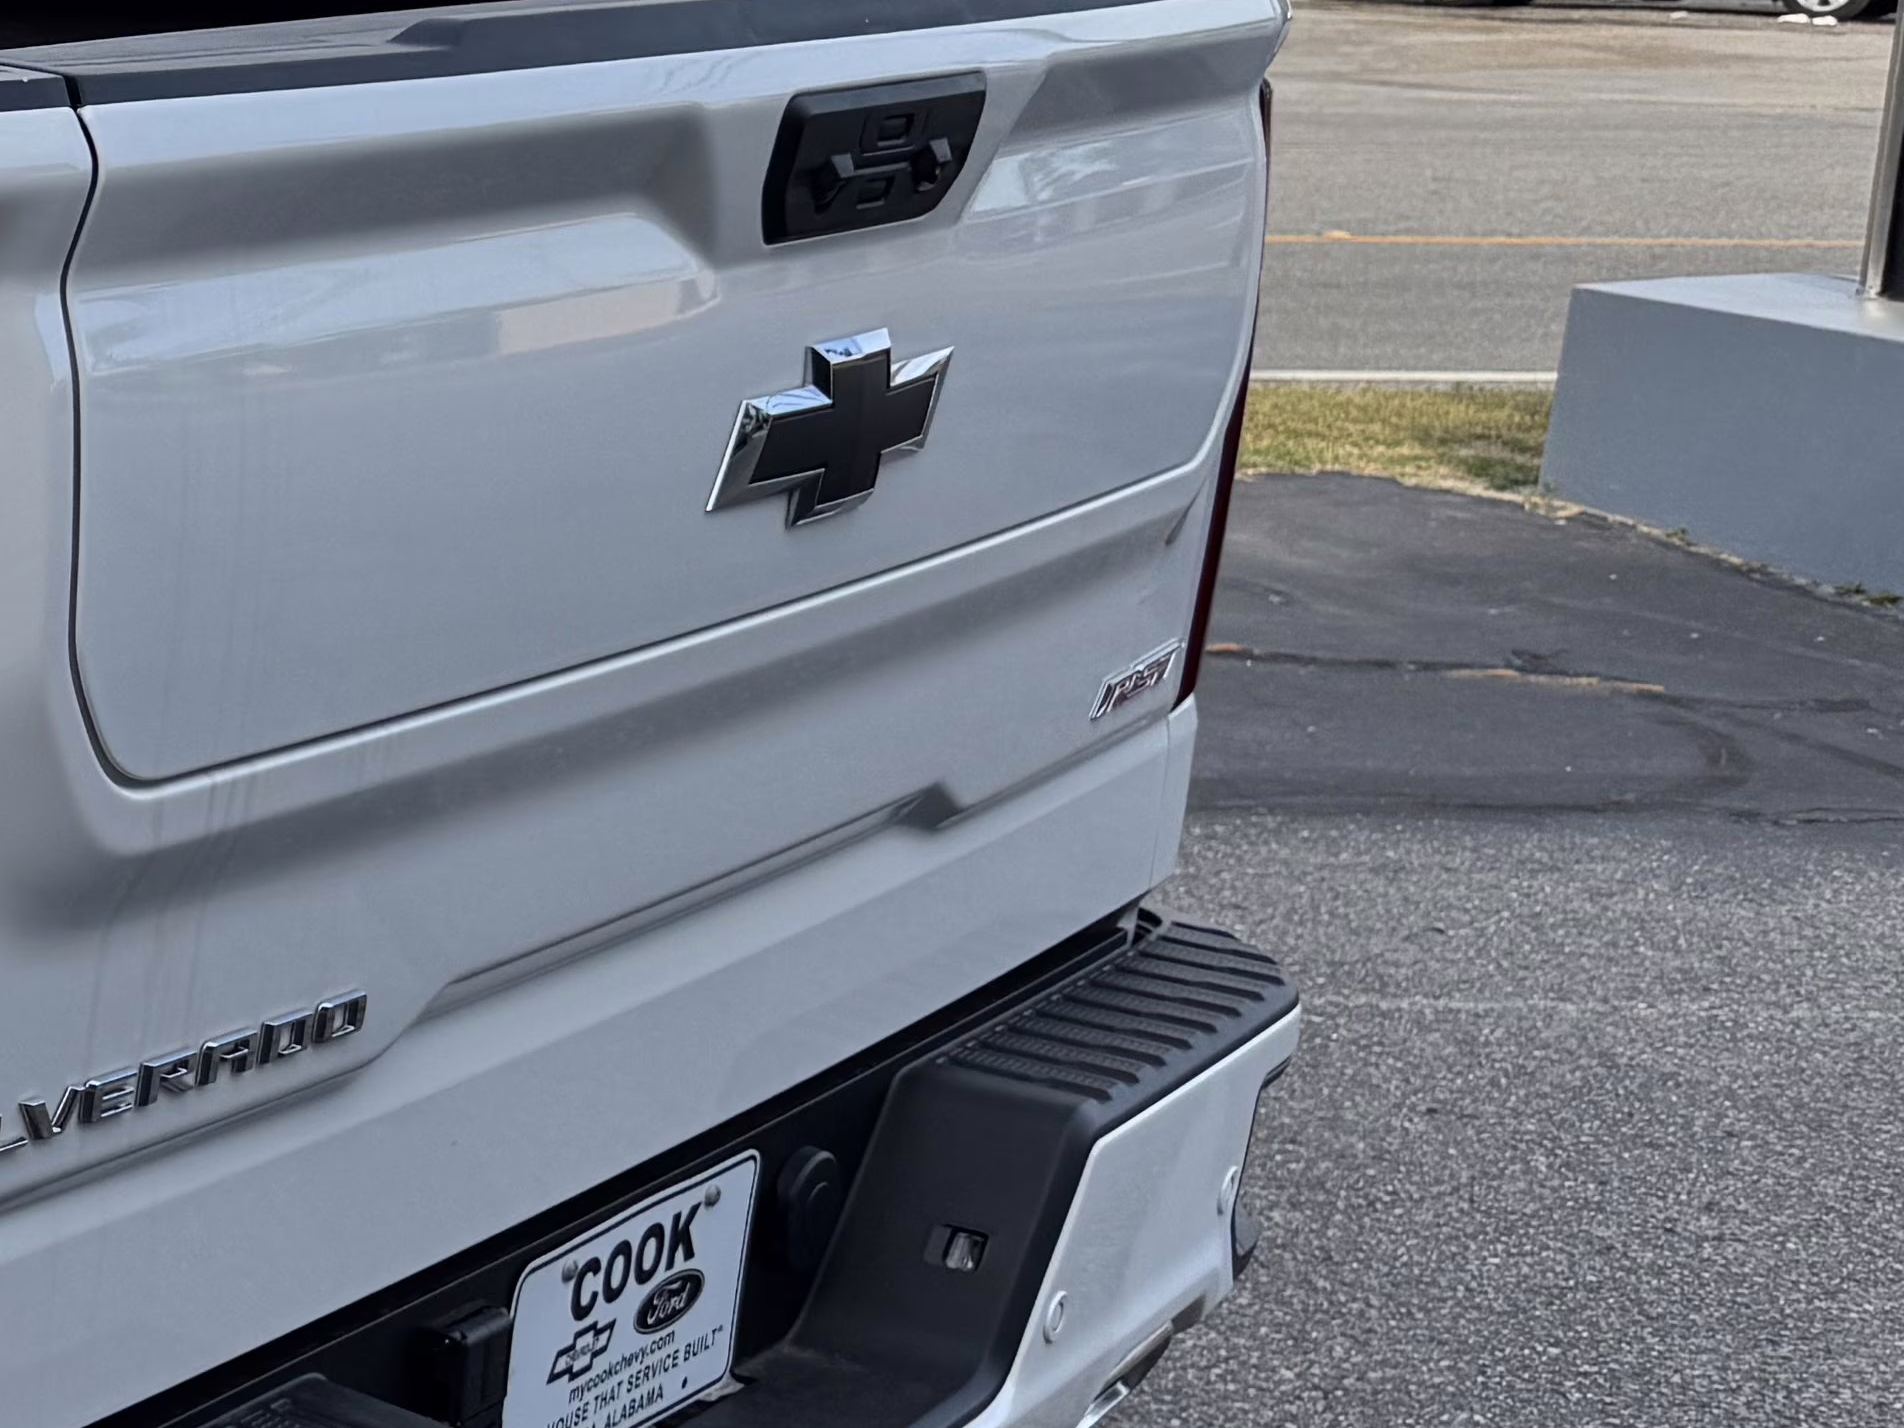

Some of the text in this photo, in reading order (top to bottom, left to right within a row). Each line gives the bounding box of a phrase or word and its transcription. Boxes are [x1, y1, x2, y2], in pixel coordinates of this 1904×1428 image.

[570, 1202, 702, 1322] COOK
[646, 1280, 692, 1325] Ford
[568, 1329, 675, 1404] mycookchevy.com
[593, 1380, 624, 1415] THAT
[626, 1348, 680, 1393] SERVICE
